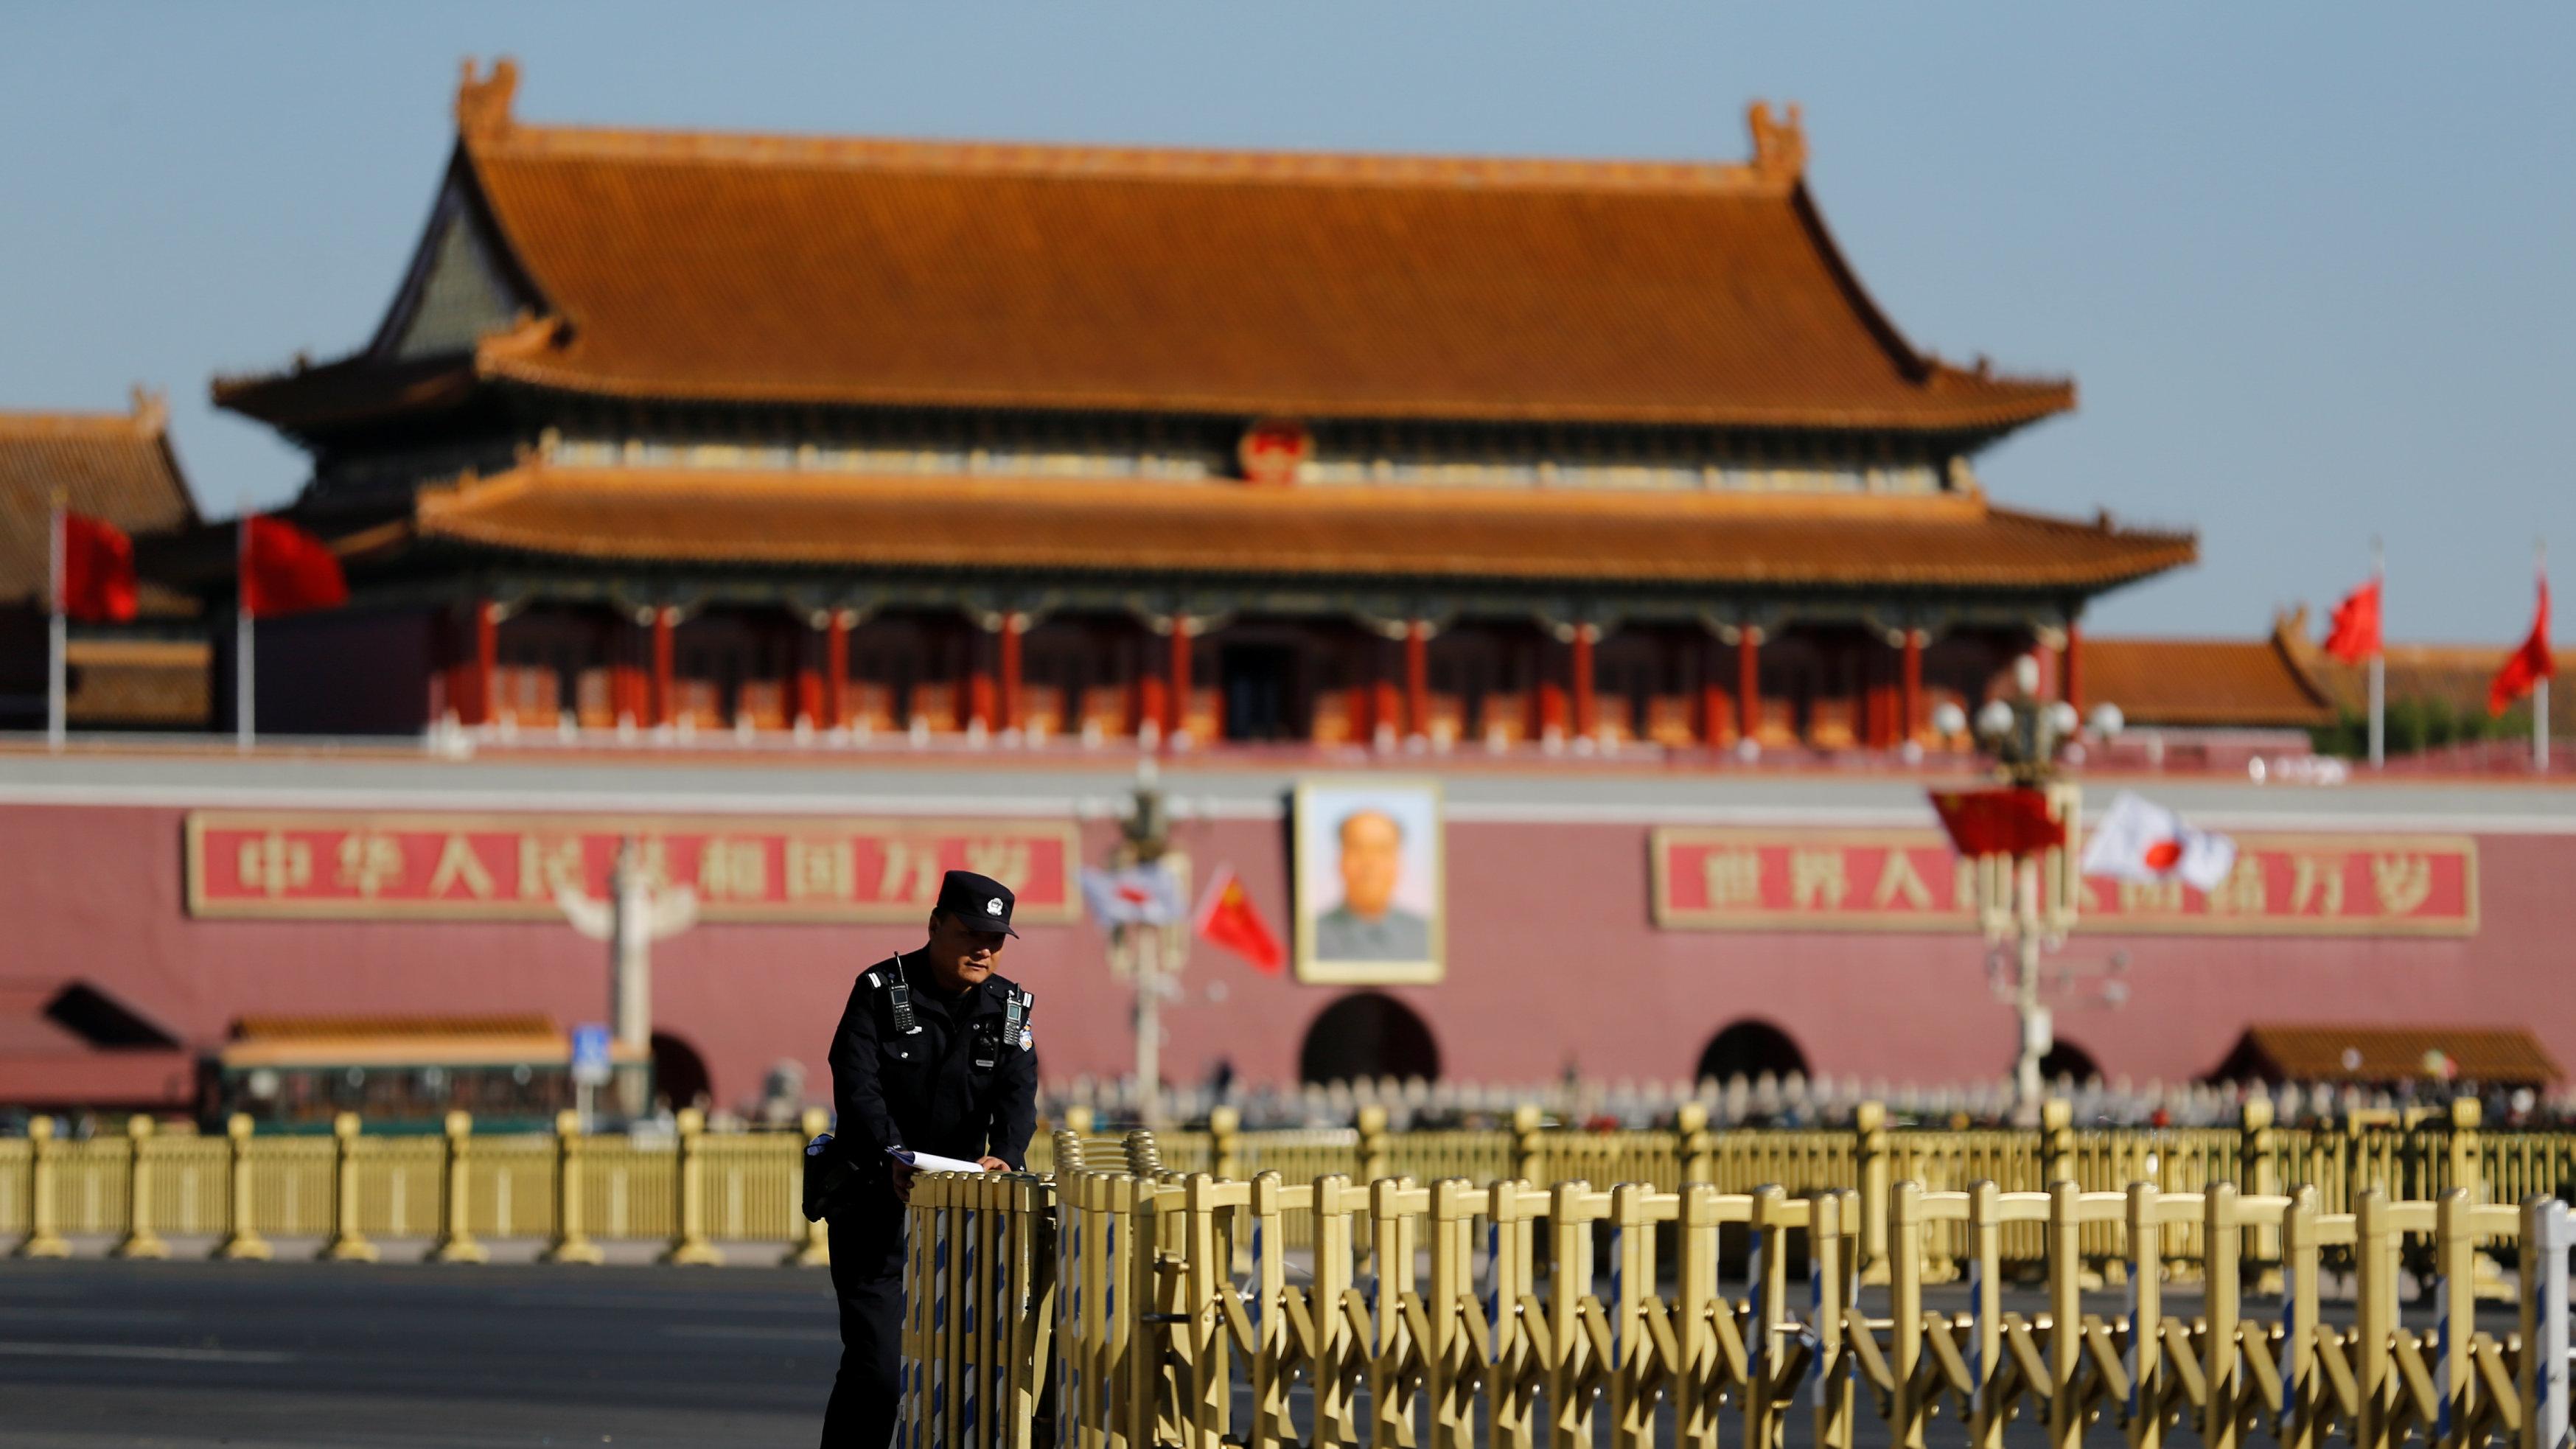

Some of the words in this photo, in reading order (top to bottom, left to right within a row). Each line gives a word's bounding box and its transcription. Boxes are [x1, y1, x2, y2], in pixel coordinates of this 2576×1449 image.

[1706, 848, 2431, 912] 世界人结万岁
